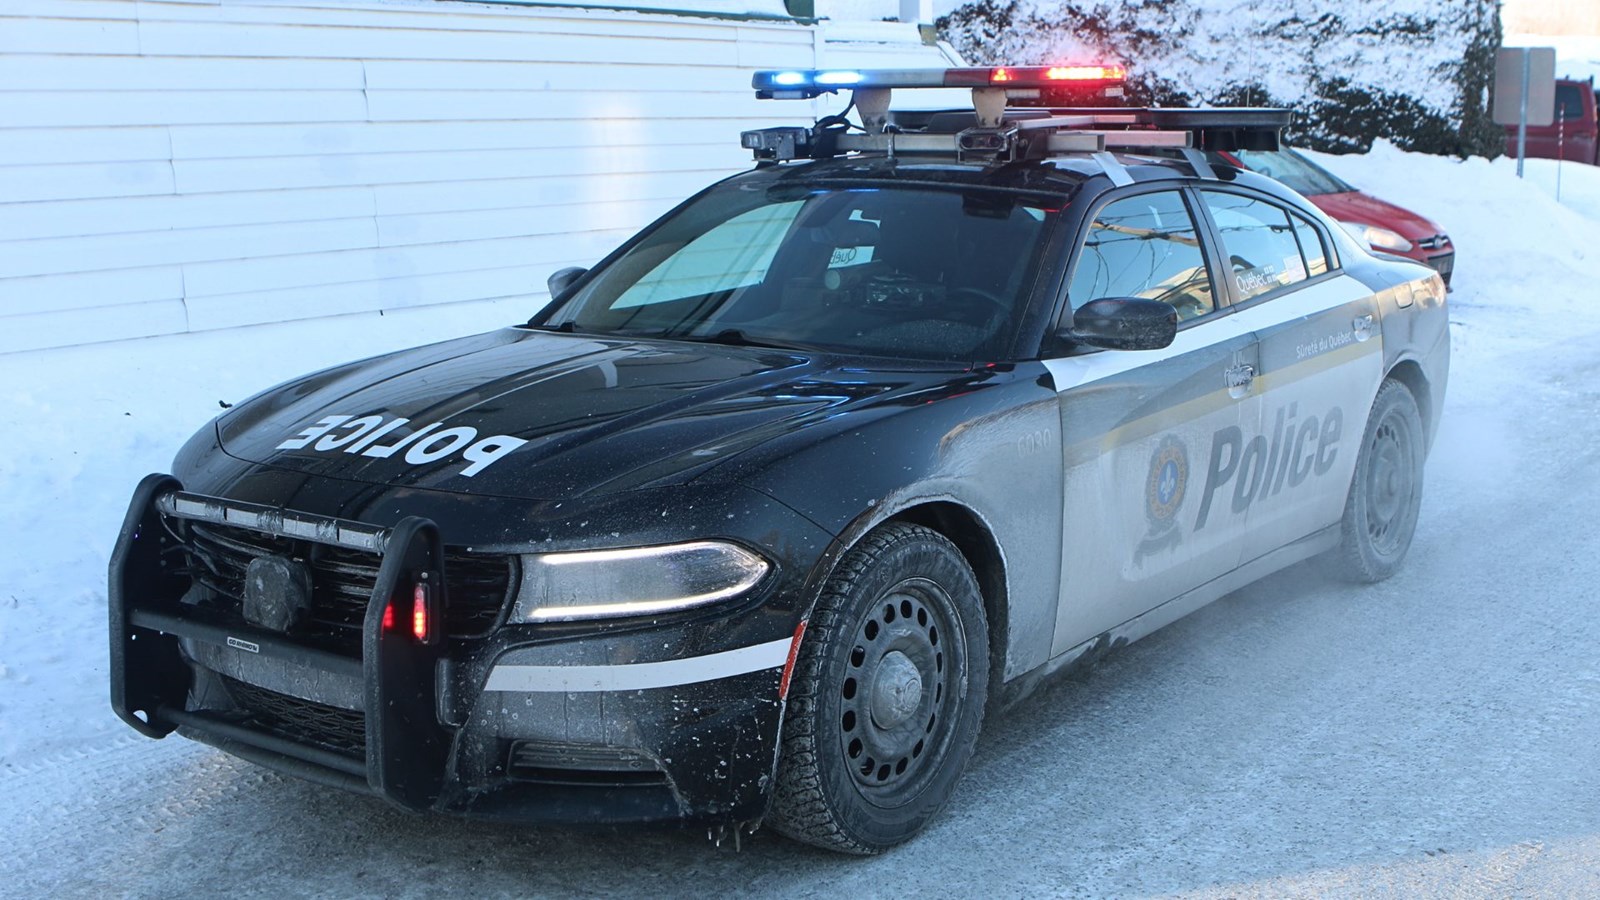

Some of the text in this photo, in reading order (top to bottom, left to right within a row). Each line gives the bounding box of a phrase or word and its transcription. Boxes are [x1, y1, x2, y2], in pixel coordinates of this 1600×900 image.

[1236, 271, 1267, 294] Québec
[1296, 331, 1352, 359] Sûreté du Québec
[1193, 400, 1344, 533] Police
